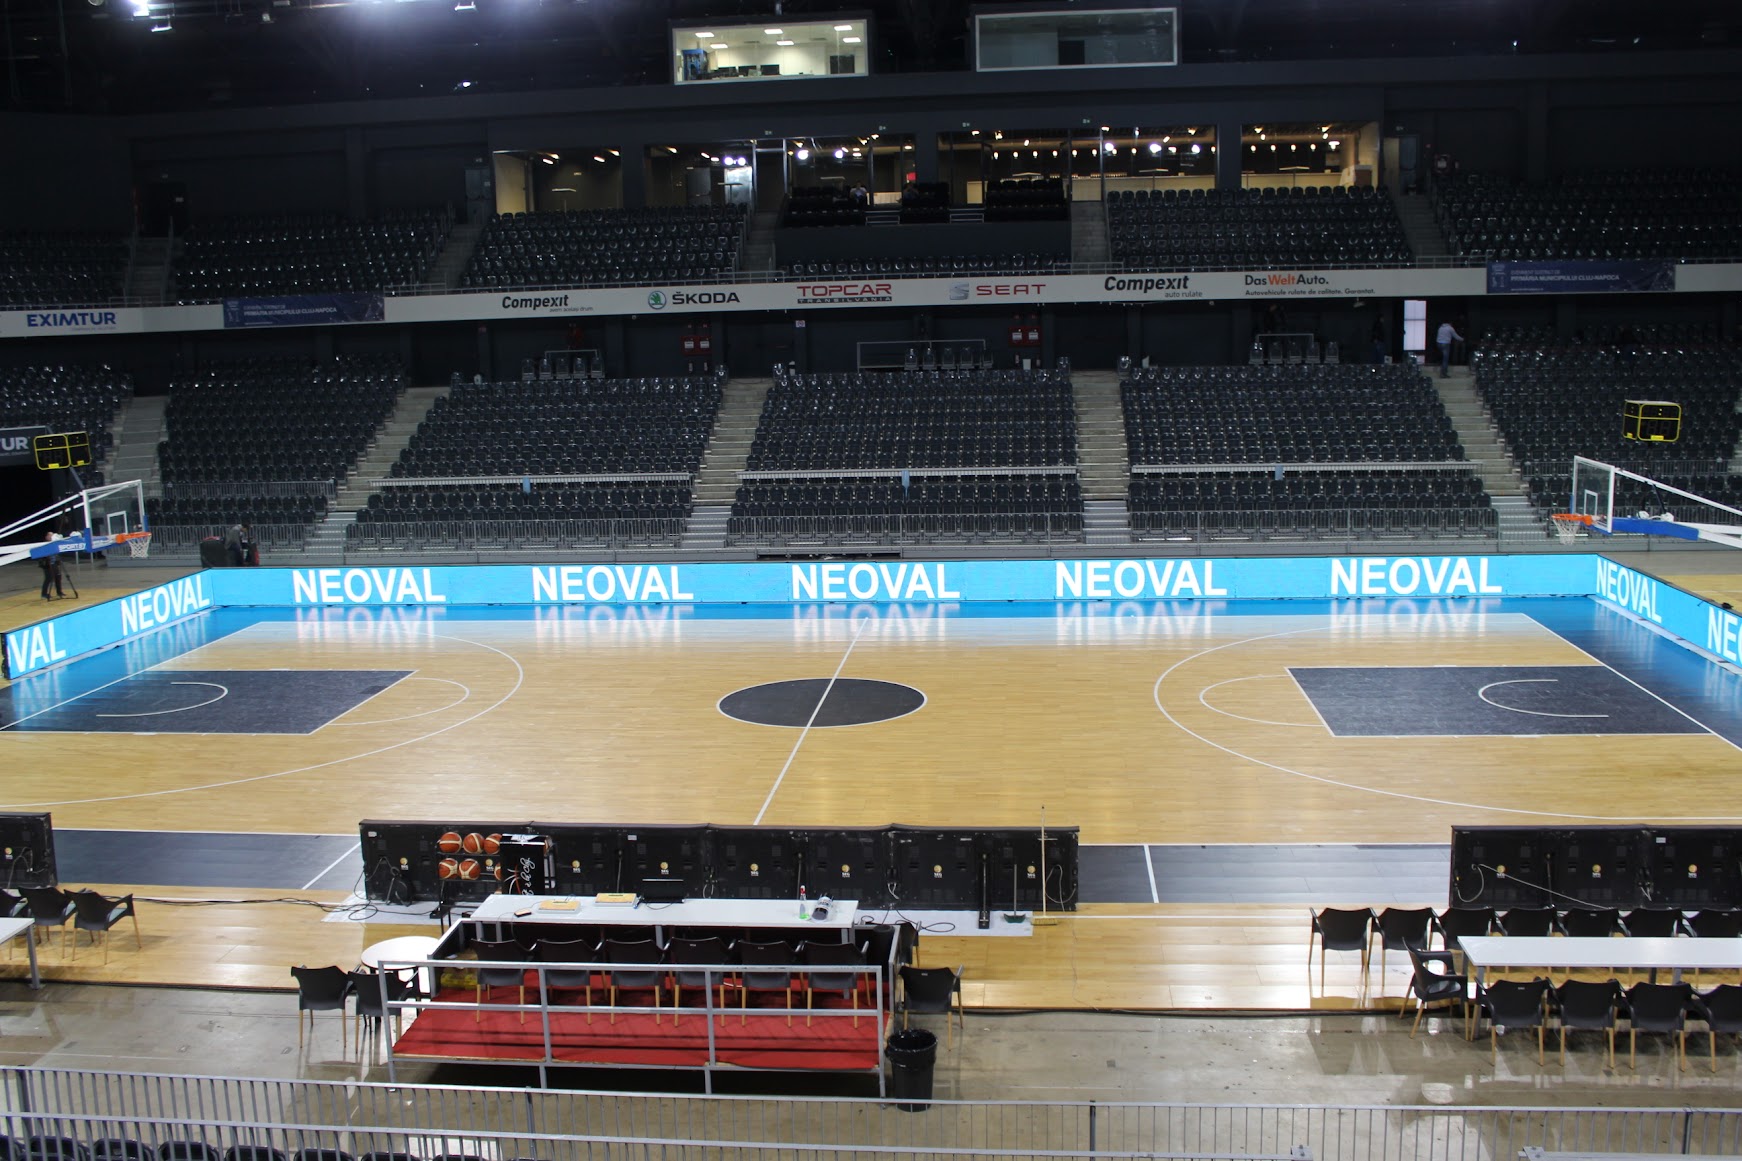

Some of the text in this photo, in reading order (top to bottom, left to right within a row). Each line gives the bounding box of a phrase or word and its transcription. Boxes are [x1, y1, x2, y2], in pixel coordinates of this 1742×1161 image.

[796, 283, 892, 297] TOPCAR
[976, 284, 1046, 296] SEAT
[1104, 275, 1189, 293] Compexit
[1182, 290, 1203, 298] rulate
[502, 294, 569, 311] Compexit
[672, 291, 740, 305] ŠKODA
[798, 296, 892, 304] TRANSILVANIA
[26, 312, 117, 327] EXIMTUR
[0, 436, 29, 451] UR
[293, 569, 446, 602] NEOVAL
[533, 566, 694, 600] NEOVAL
[793, 564, 960, 598] NEOVAL
[1057, 561, 1227, 596] NEOVAL
[1332, 558, 1502, 594] NEOVAL
[1596, 557, 1662, 623] NEOVAL
[120, 575, 210, 636] NEOVAL
[8, 622, 66, 673] VAL
[1707, 606, 1742, 664] NE
